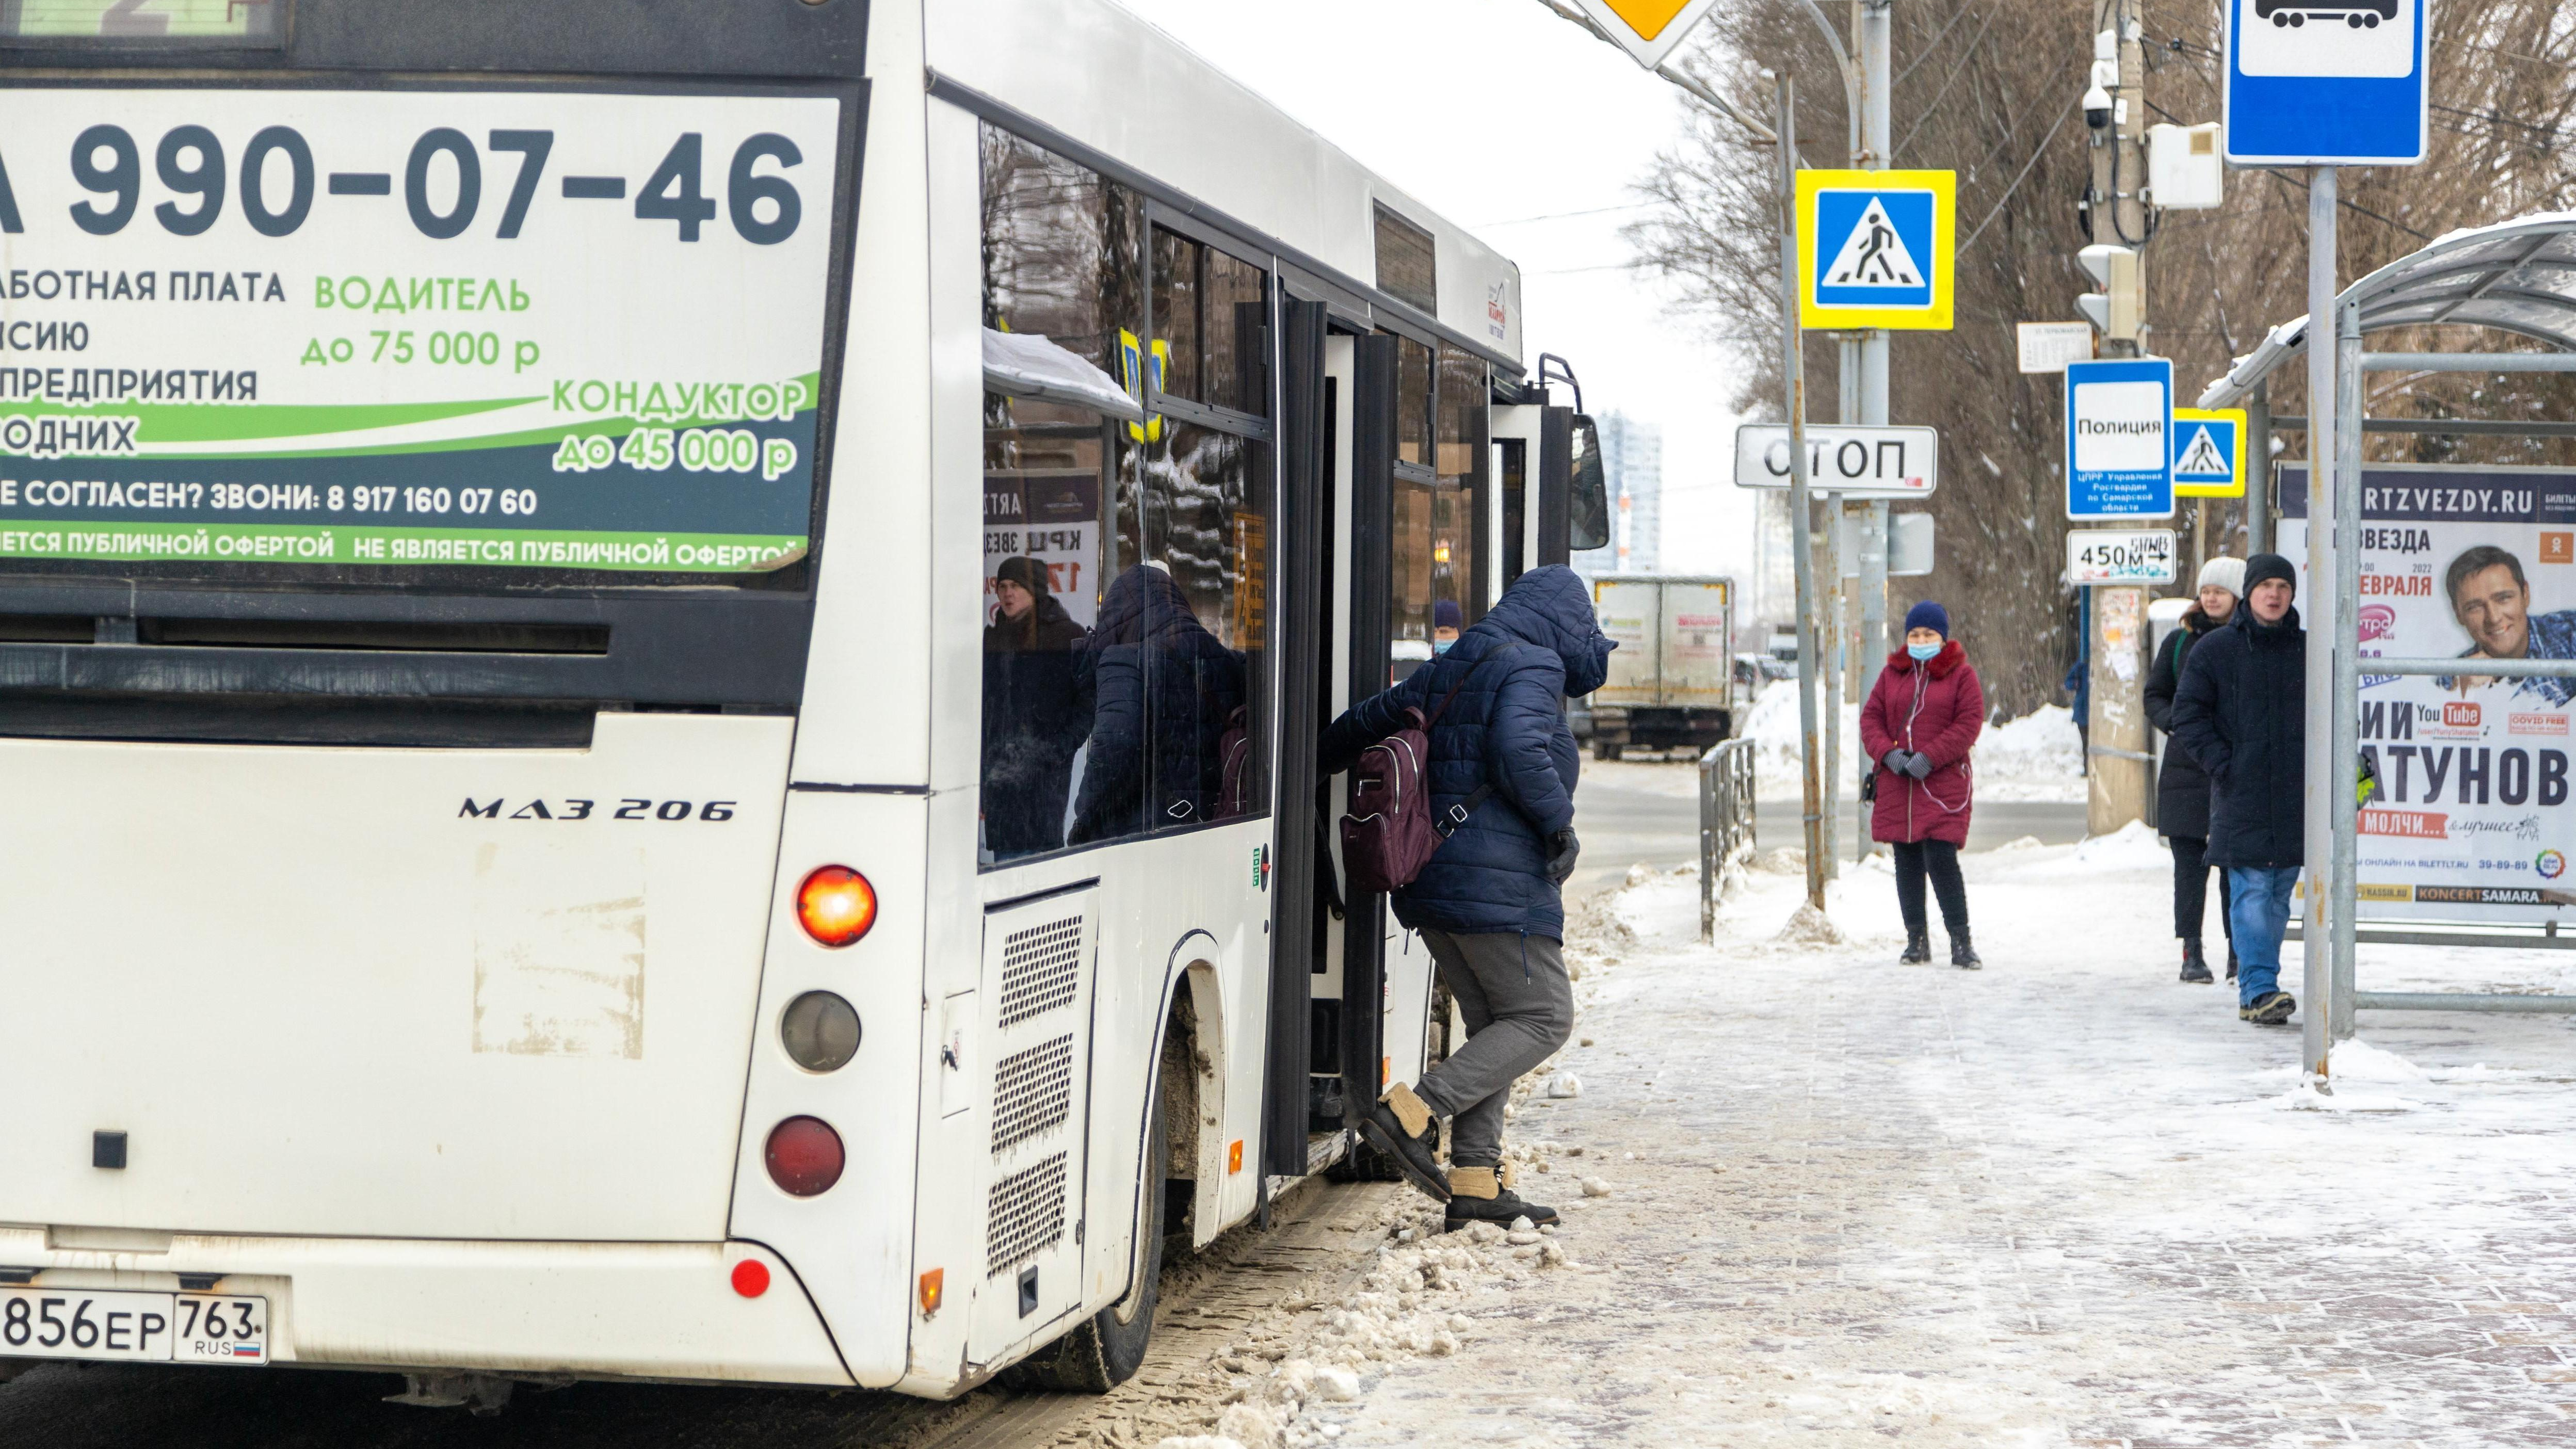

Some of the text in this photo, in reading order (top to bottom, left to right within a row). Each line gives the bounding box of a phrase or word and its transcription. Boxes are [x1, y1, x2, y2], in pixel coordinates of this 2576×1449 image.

[69, 123, 803, 246] 990-07-46
[0, 269, 286, 302] БОТНАЯ ПЛАТА
[314, 275, 530, 314] ВОДИТЕЛЬ
[0, 320, 89, 351] СИЮ
[369, 331, 414, 364] 75
[428, 331, 500, 365] 000
[0, 367, 258, 401] ПРЕДПРИЯТИЯ
[553, 379, 805, 418] КОНДУКТОР
[4, 419, 135, 454] ОДНИХ
[2078, 418, 2162, 437] Полиция
[622, 431, 670, 465] 45
[683, 433, 754, 468] 000
[1764, 438, 1905, 478] СТОП
[2078, 472, 2163, 482] ЦПРР Управления
[2093, 482, 2147, 492] Росгвардии
[25, 480, 202, 509] СОГЛАСЕН?
[210, 483, 320, 510] ЗВОНИ:
[327, 486, 343, 511] 8
[353, 486, 396, 512] 917
[404, 487, 450, 512] 160
[459, 489, 492, 513] 07
[500, 489, 537, 514] 60
[2102, 493, 2153, 503] Самарской
[2365, 487, 2533, 514] RTZVEZDY.RU
[0, 529, 333, 558] ЕТСЯ ПУБЛИЧНОЙ ОФЕРТОЙ
[354, 539, 384, 559] НЕ
[391, 539, 514, 561] ЯВЛЯЕТСЯ
[521, 537, 669, 565] ПУБЛИЧНОЙ
[2412, 564, 2432, 573] 2022
[2359, 574, 2432, 596] ЕВРАЛЯ
[2360, 700, 2413, 740] ИЙ
[2546, 717, 2567, 725] FREE
[2360, 745, 2568, 806] АТУНОВ
[457, 797, 737, 822] МАЗ 206
[2364, 811, 2440, 835] МОЛЧИ...
[2364, 858, 2402, 867] ОНЛАЙН
[2404, 860, 2416, 868] НА
[2478, 860, 2528, 870] 39-89-89
[2419, 888, 2552, 903] KONCERTSAMARA.
[4, 1297, 253, 1351] 856ЕР 763
[195, 1341, 232, 1355] RUS
